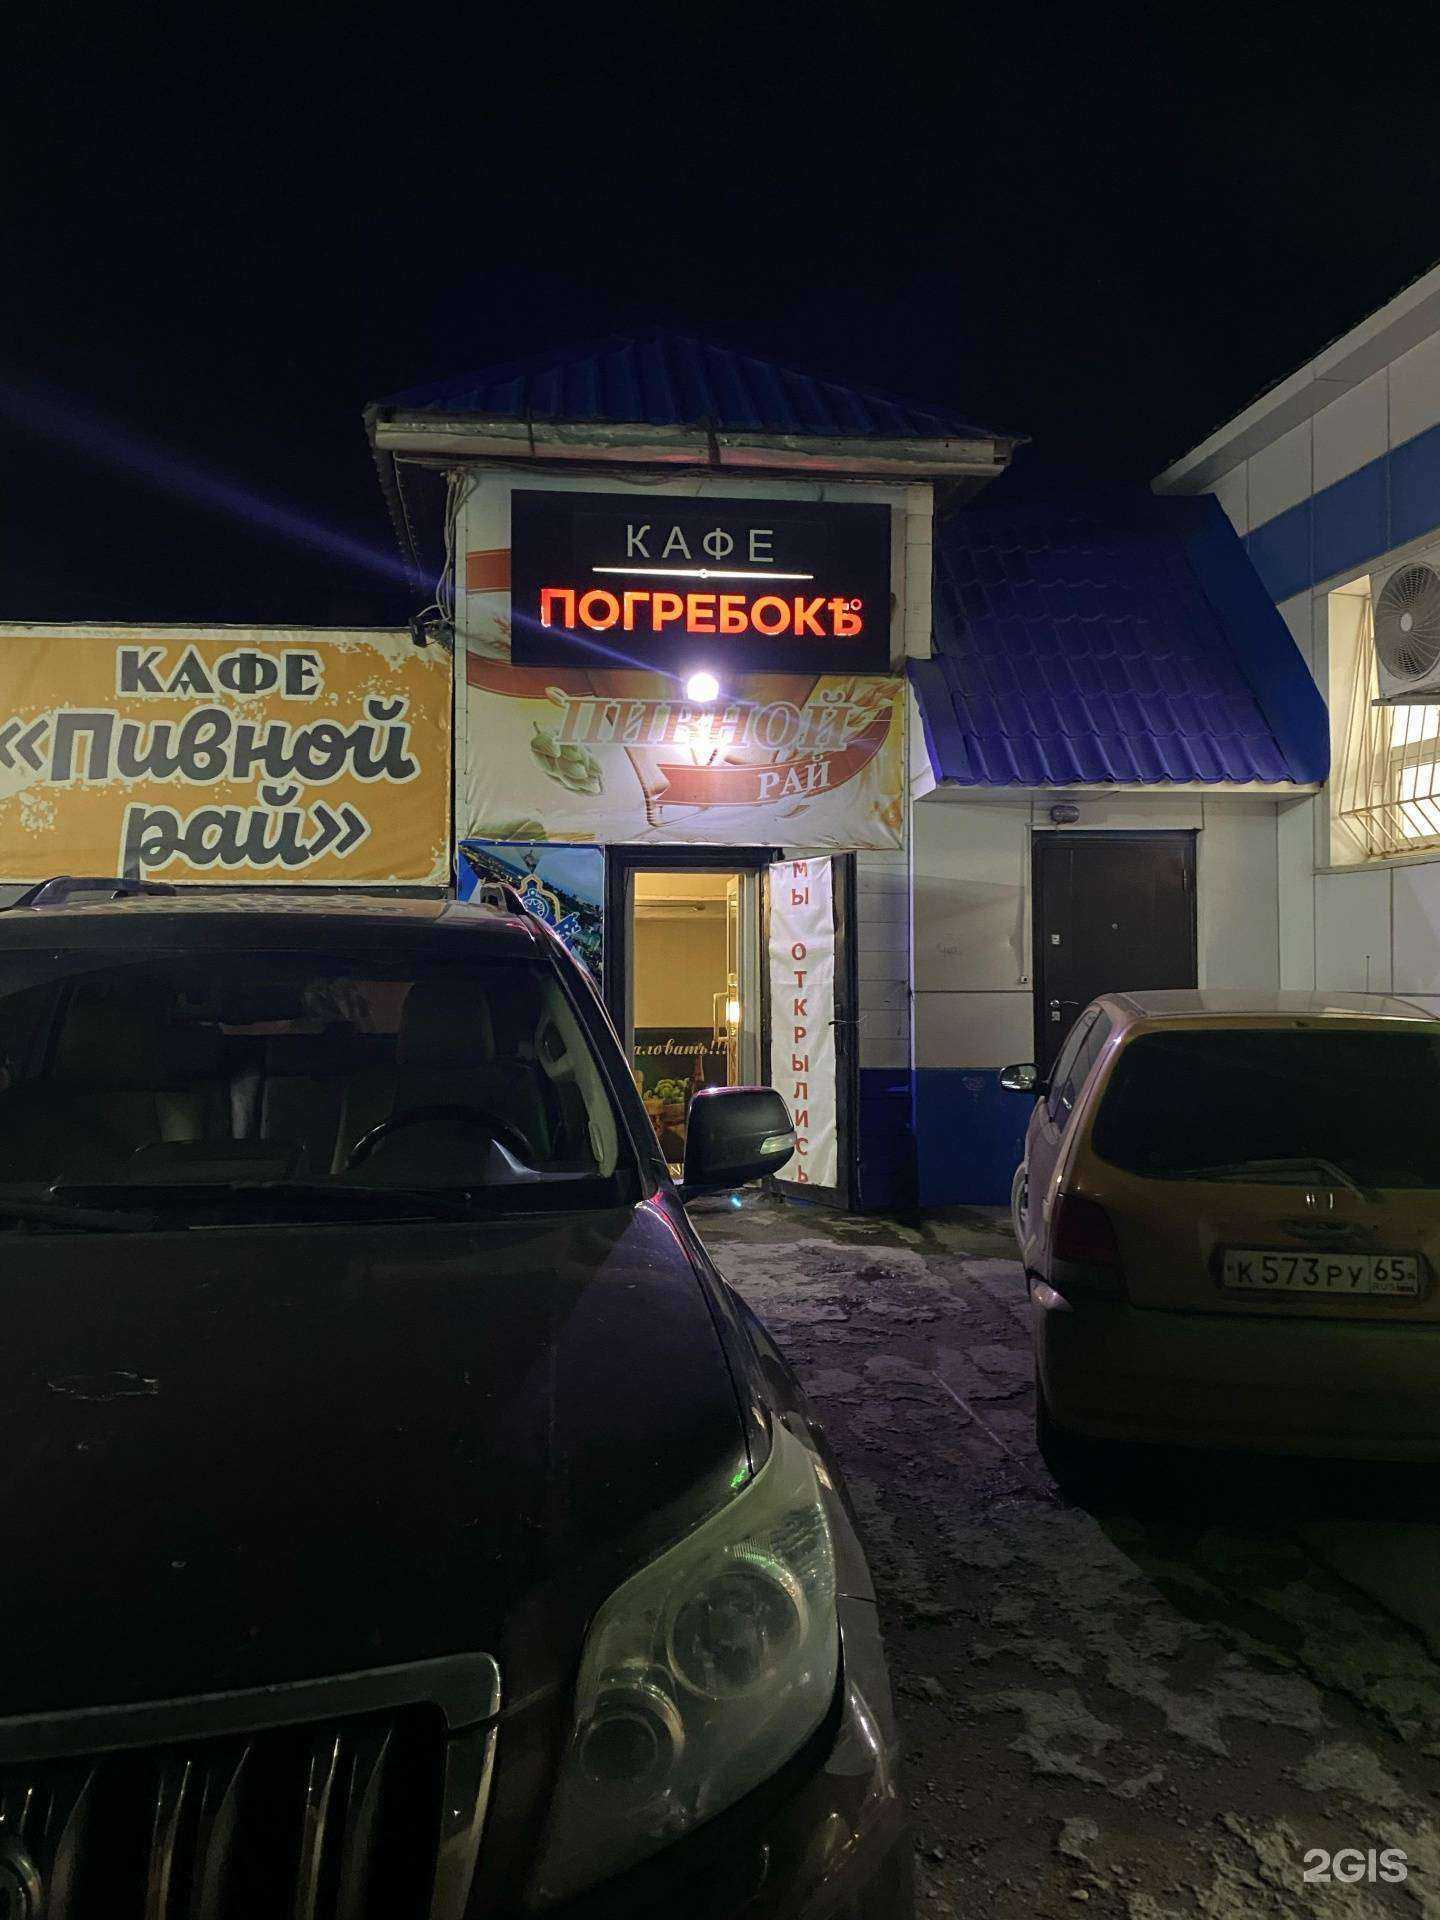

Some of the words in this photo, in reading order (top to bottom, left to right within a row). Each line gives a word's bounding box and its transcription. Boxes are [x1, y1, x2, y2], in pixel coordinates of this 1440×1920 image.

[625, 524, 775, 563] КАФЕ
[119, 648, 321, 695] КАФЕ
[756, 754, 832, 801] РАЙ
[791, 861, 809, 906] МЫ
[791, 942, 810, 1184] ОТКРЫЛИСЬ
